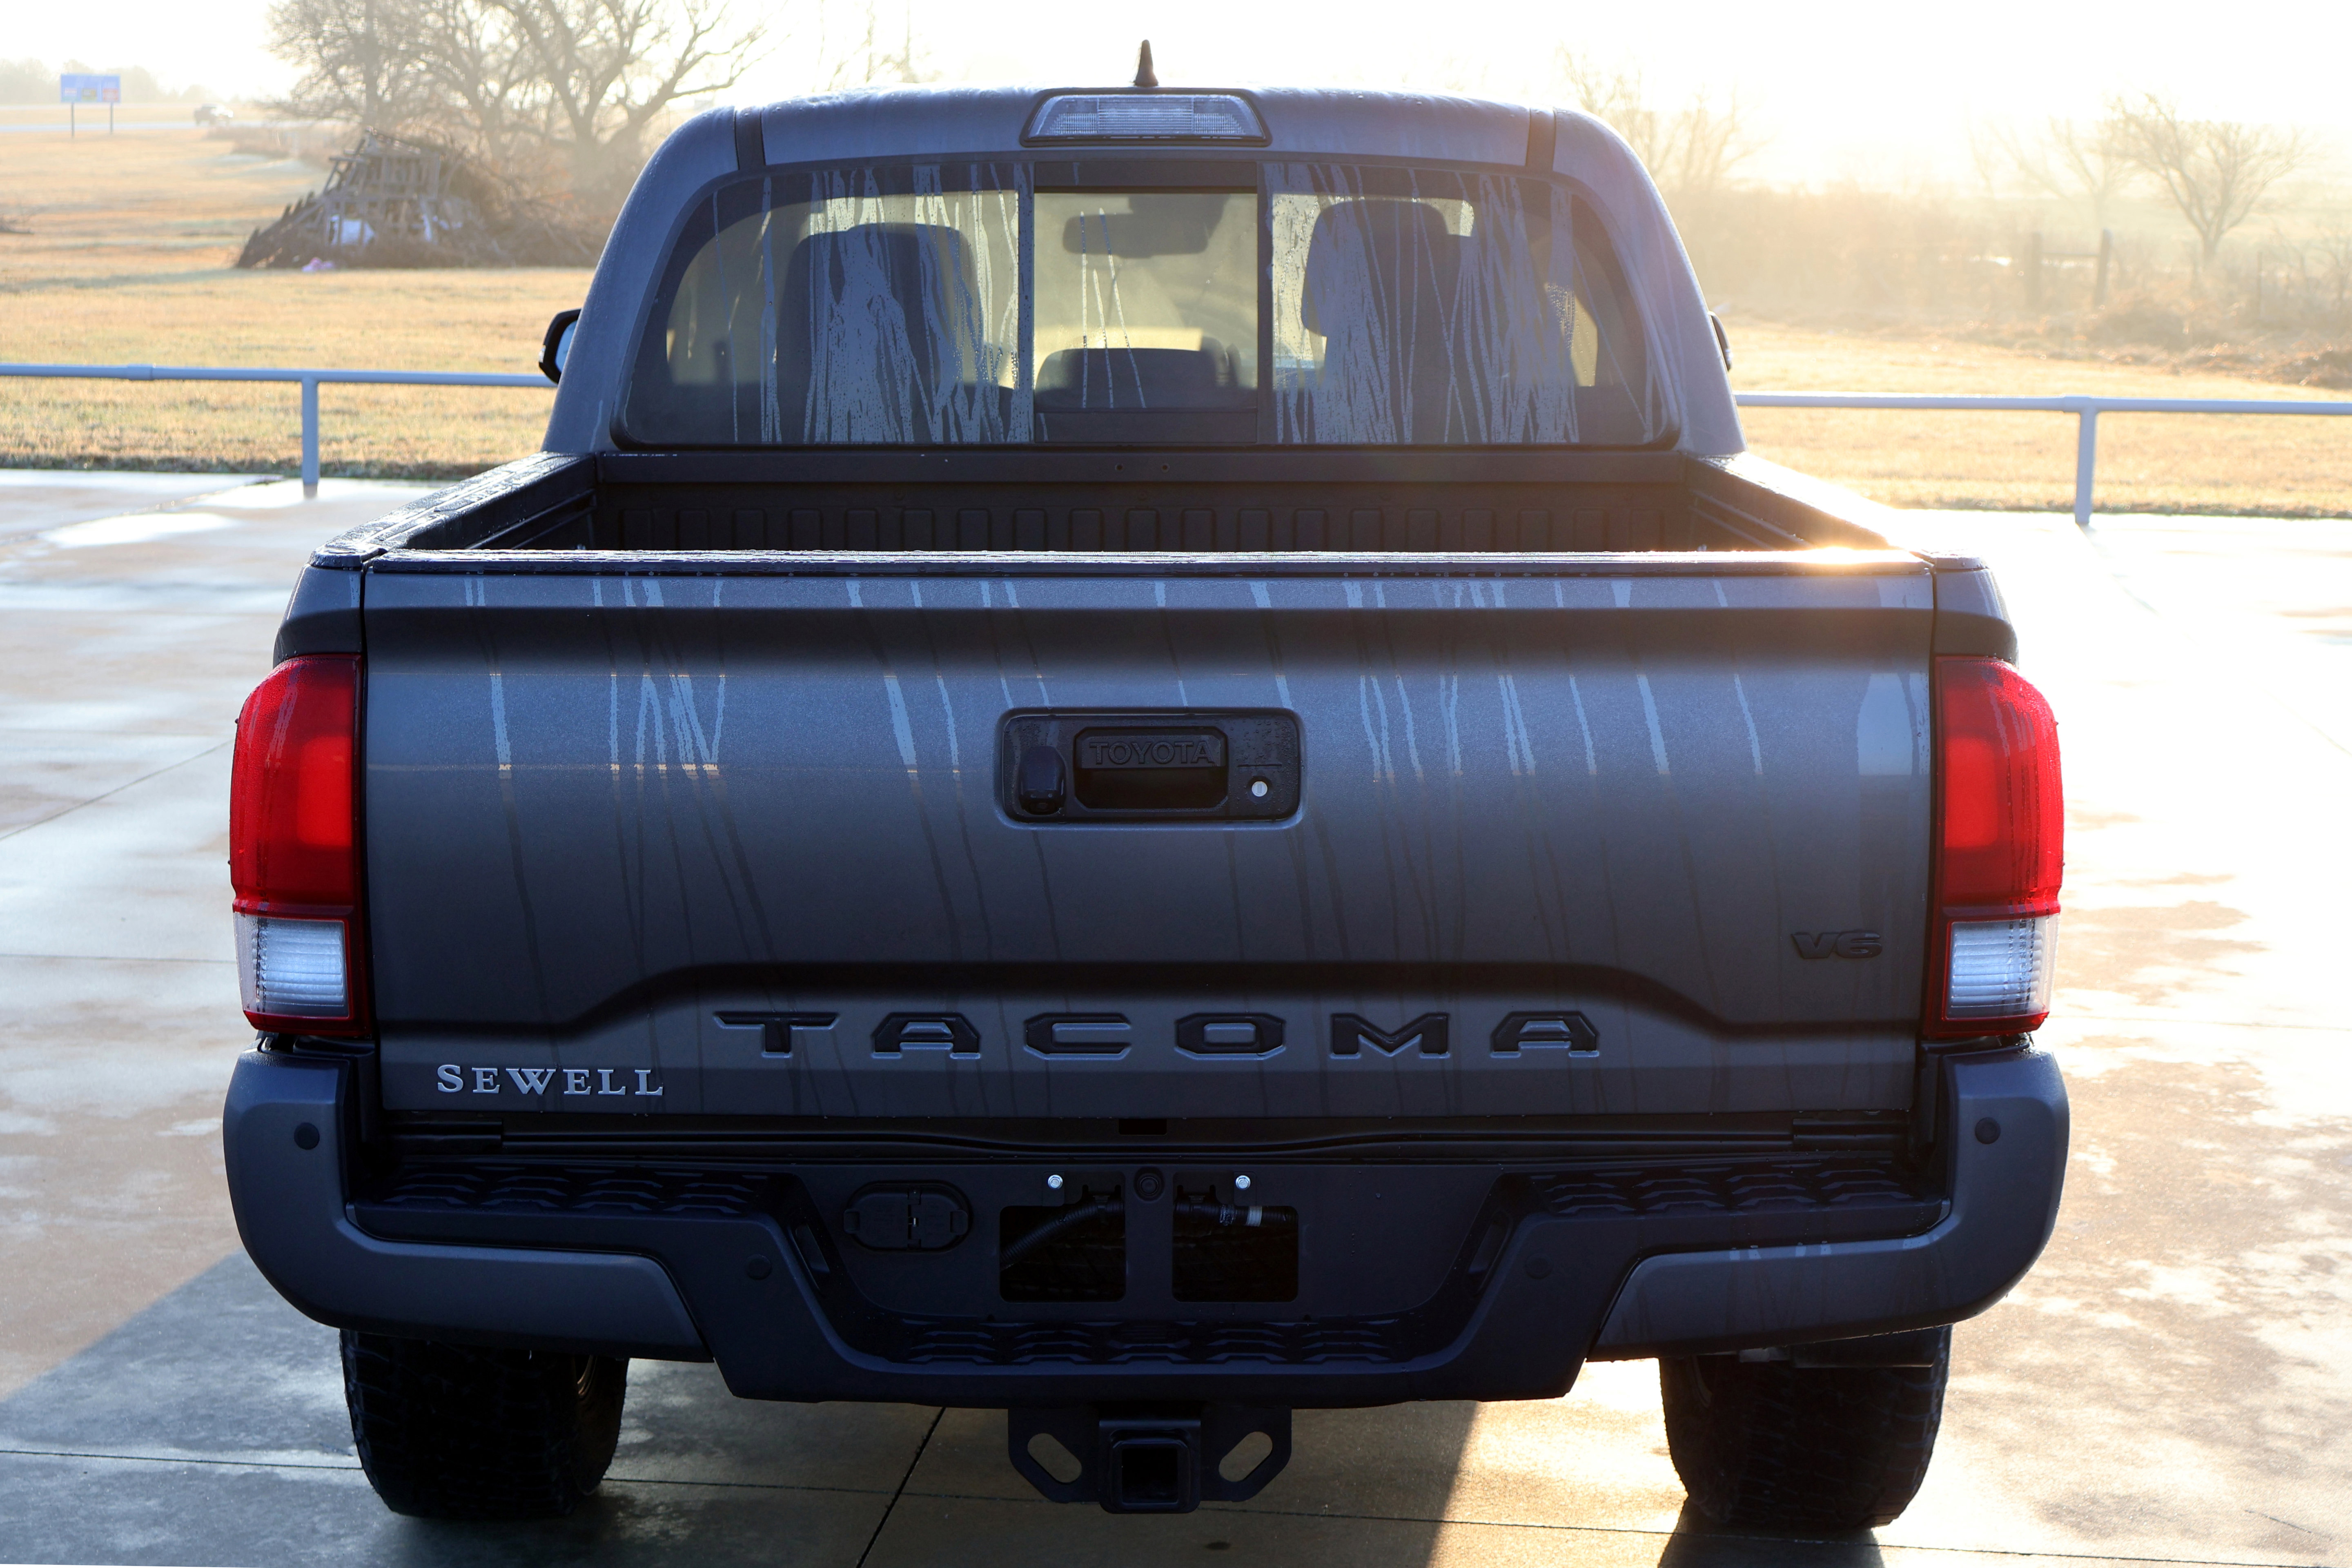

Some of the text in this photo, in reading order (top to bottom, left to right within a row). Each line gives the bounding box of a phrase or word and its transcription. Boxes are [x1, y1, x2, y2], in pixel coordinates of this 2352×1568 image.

[1089, 741, 1215, 765] TOYOTA
[1791, 929, 1882, 959] V6
[713, 1011, 1600, 1059] TACOMA
[437, 1064, 664, 1096] SEWELL
